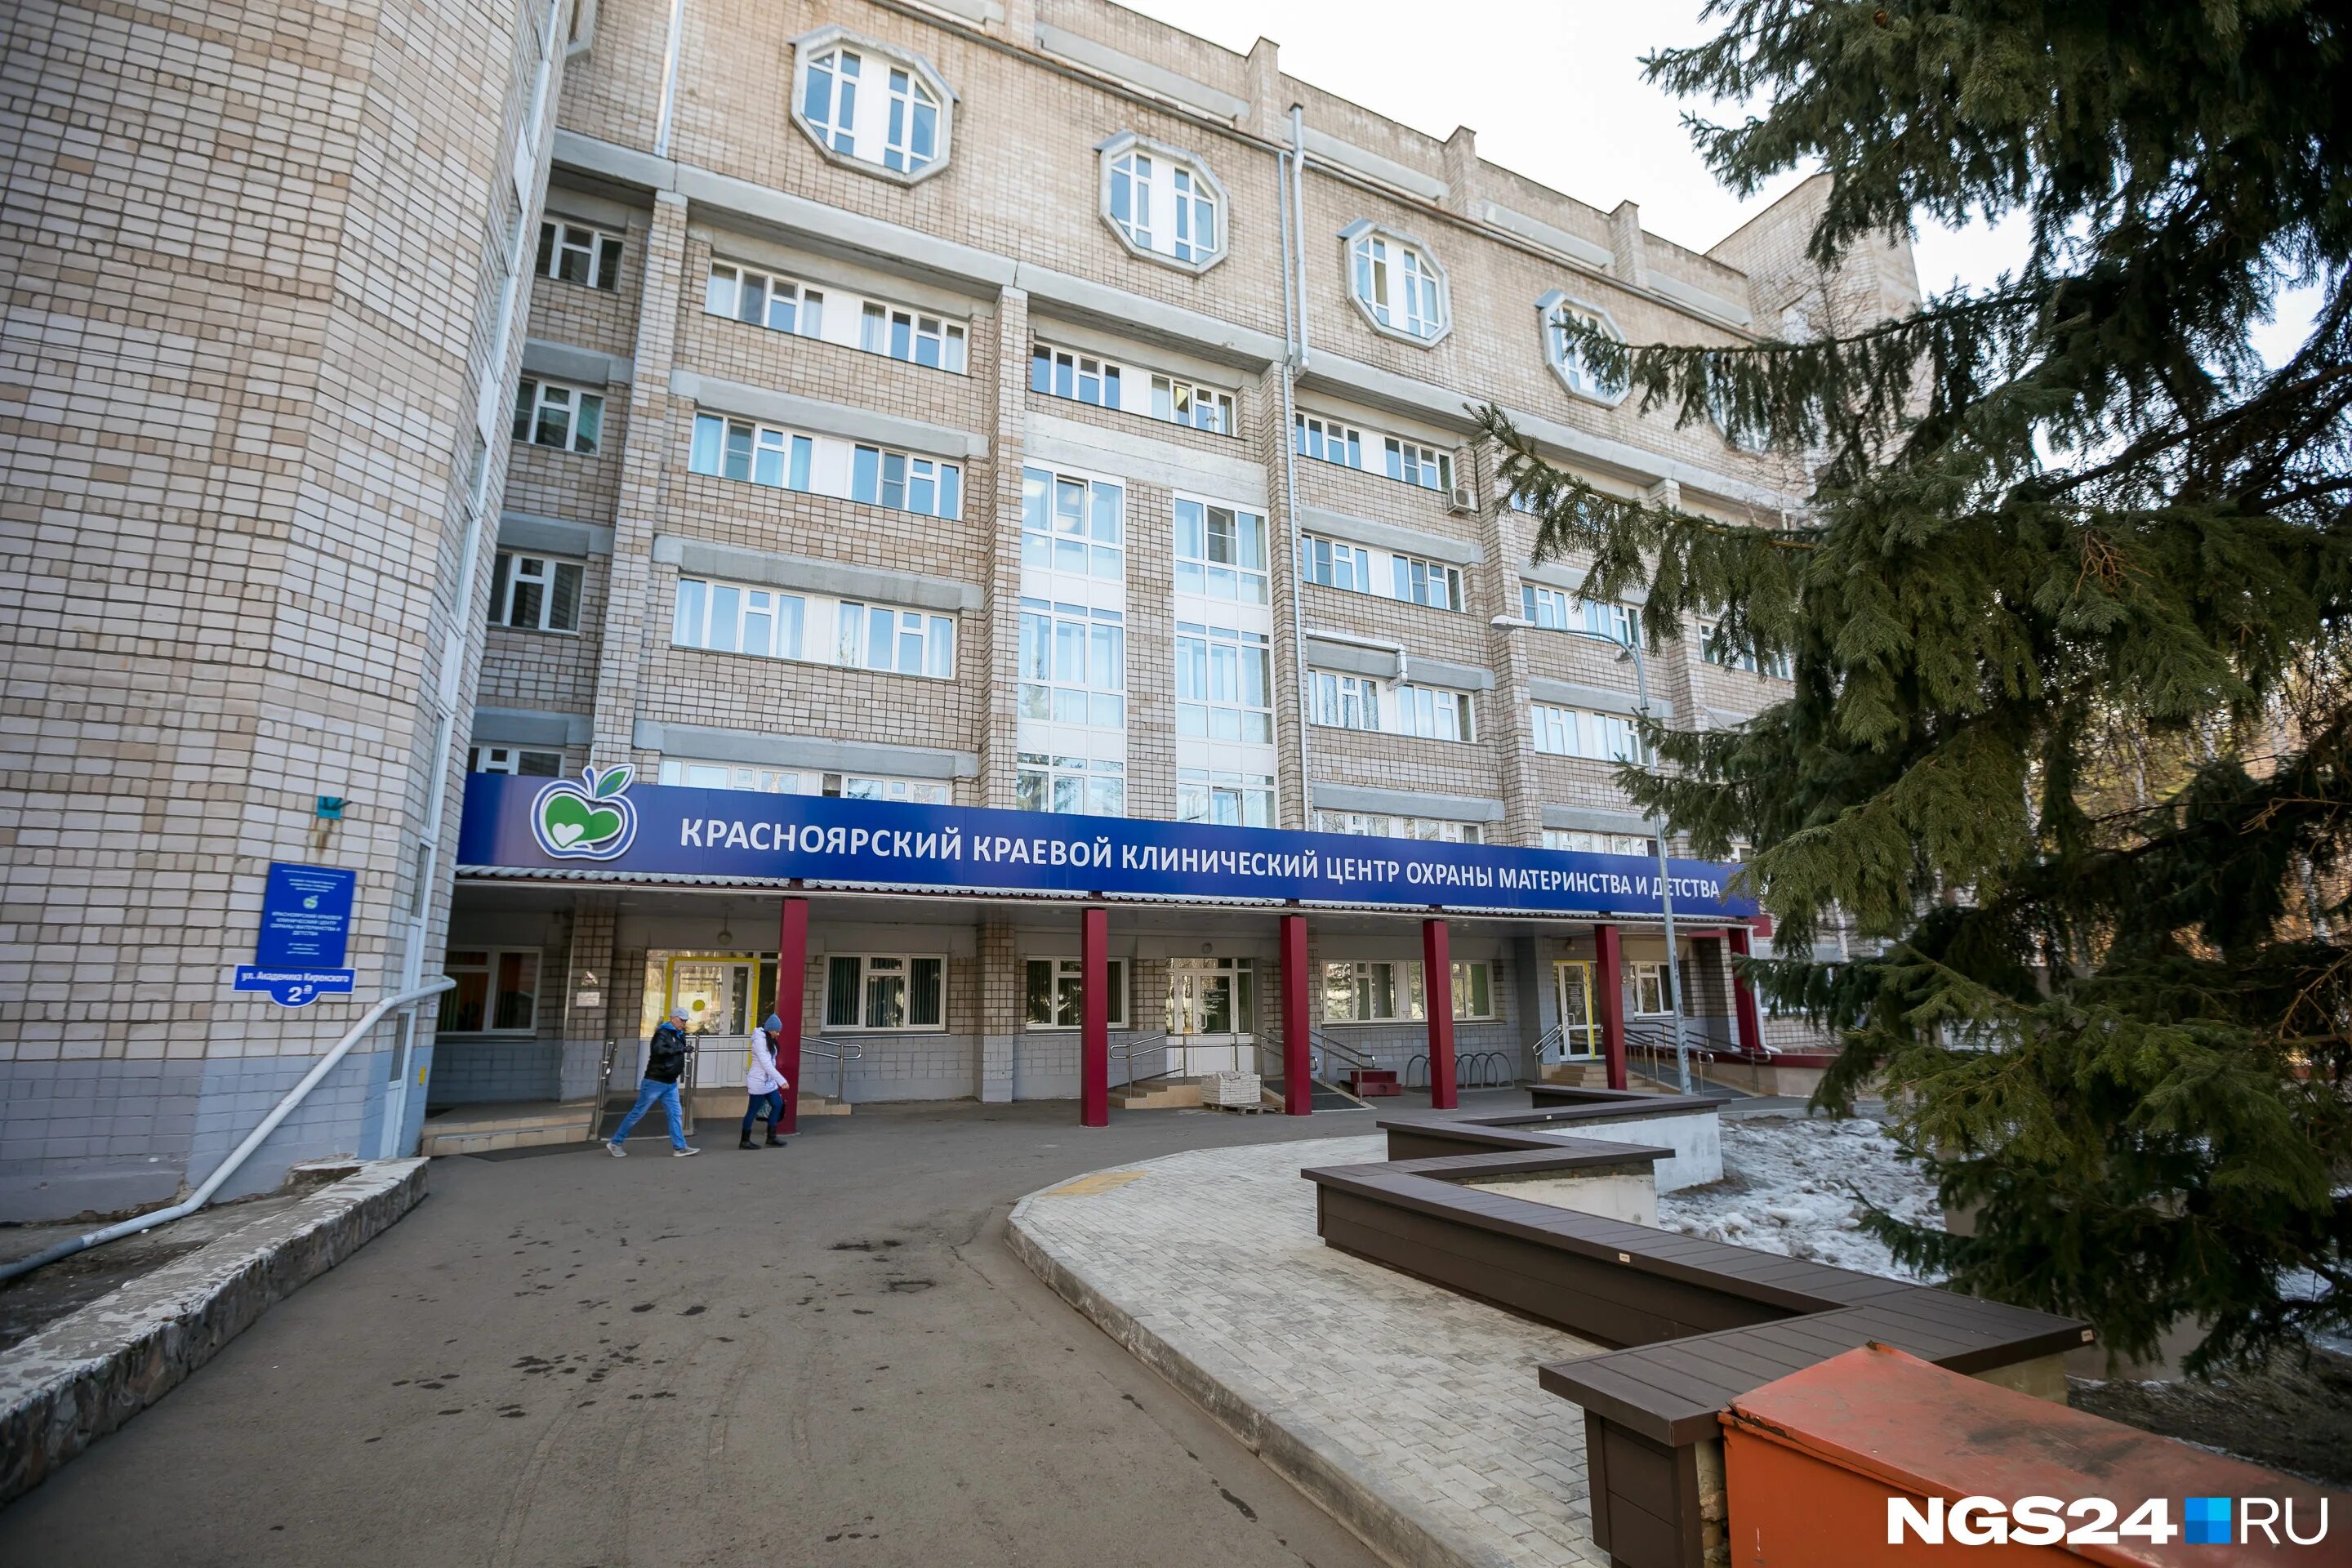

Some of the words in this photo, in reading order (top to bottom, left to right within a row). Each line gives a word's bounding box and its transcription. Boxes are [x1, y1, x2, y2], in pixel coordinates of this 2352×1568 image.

[680, 817, 962, 861] КРАСНОЯРСКИЙ
[973, 835, 1111, 868] КРАЕВОЙ
[1122, 844, 1318, 879] КЛИНИЧЕСКИЙ
[1326, 856, 1400, 885] ЦЕНТР
[1406, 862, 1493, 888] ОХРАНЫ
[1499, 867, 1633, 895] МАТЕРИНСТВА
[1635, 875, 1648, 896] И
